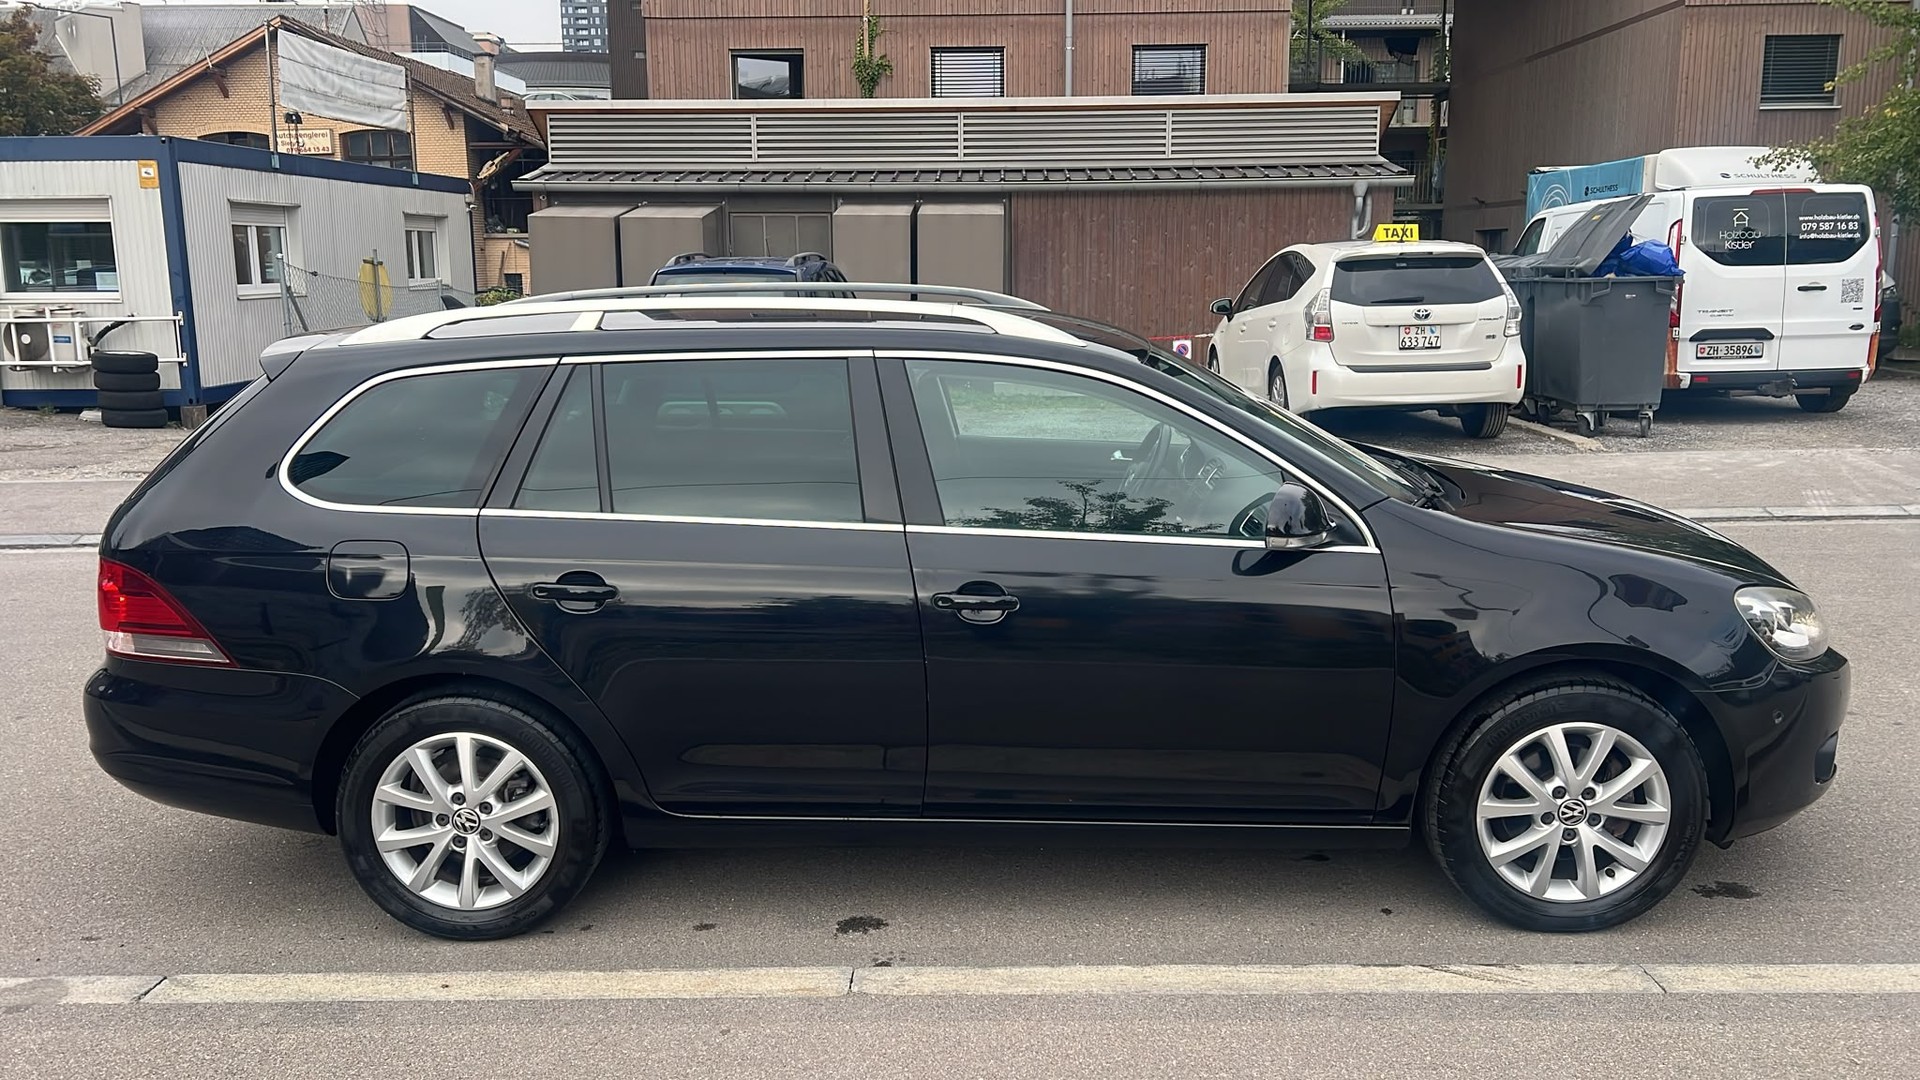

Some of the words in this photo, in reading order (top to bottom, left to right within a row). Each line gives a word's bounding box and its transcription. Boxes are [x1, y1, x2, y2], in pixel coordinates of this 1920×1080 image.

[1590, 184, 1619, 194] SCHULTHESS
[1799, 213, 1860, 221] www.holzbau-kistler.ch
[1801, 222, 1817, 231] 079
[1819, 222, 1834, 231] 587
[1837, 221, 1847, 230] 16
[1848, 221, 1859, 230] 83
[1383, 227, 1414, 239] TAXI
[1719, 230, 1761, 239] Holzbau
[1725, 240, 1755, 250] Kistler
[1415, 326, 1426, 335] ZH
[1401, 336, 1419, 348] 633
[1421, 335, 1440, 347] 747
